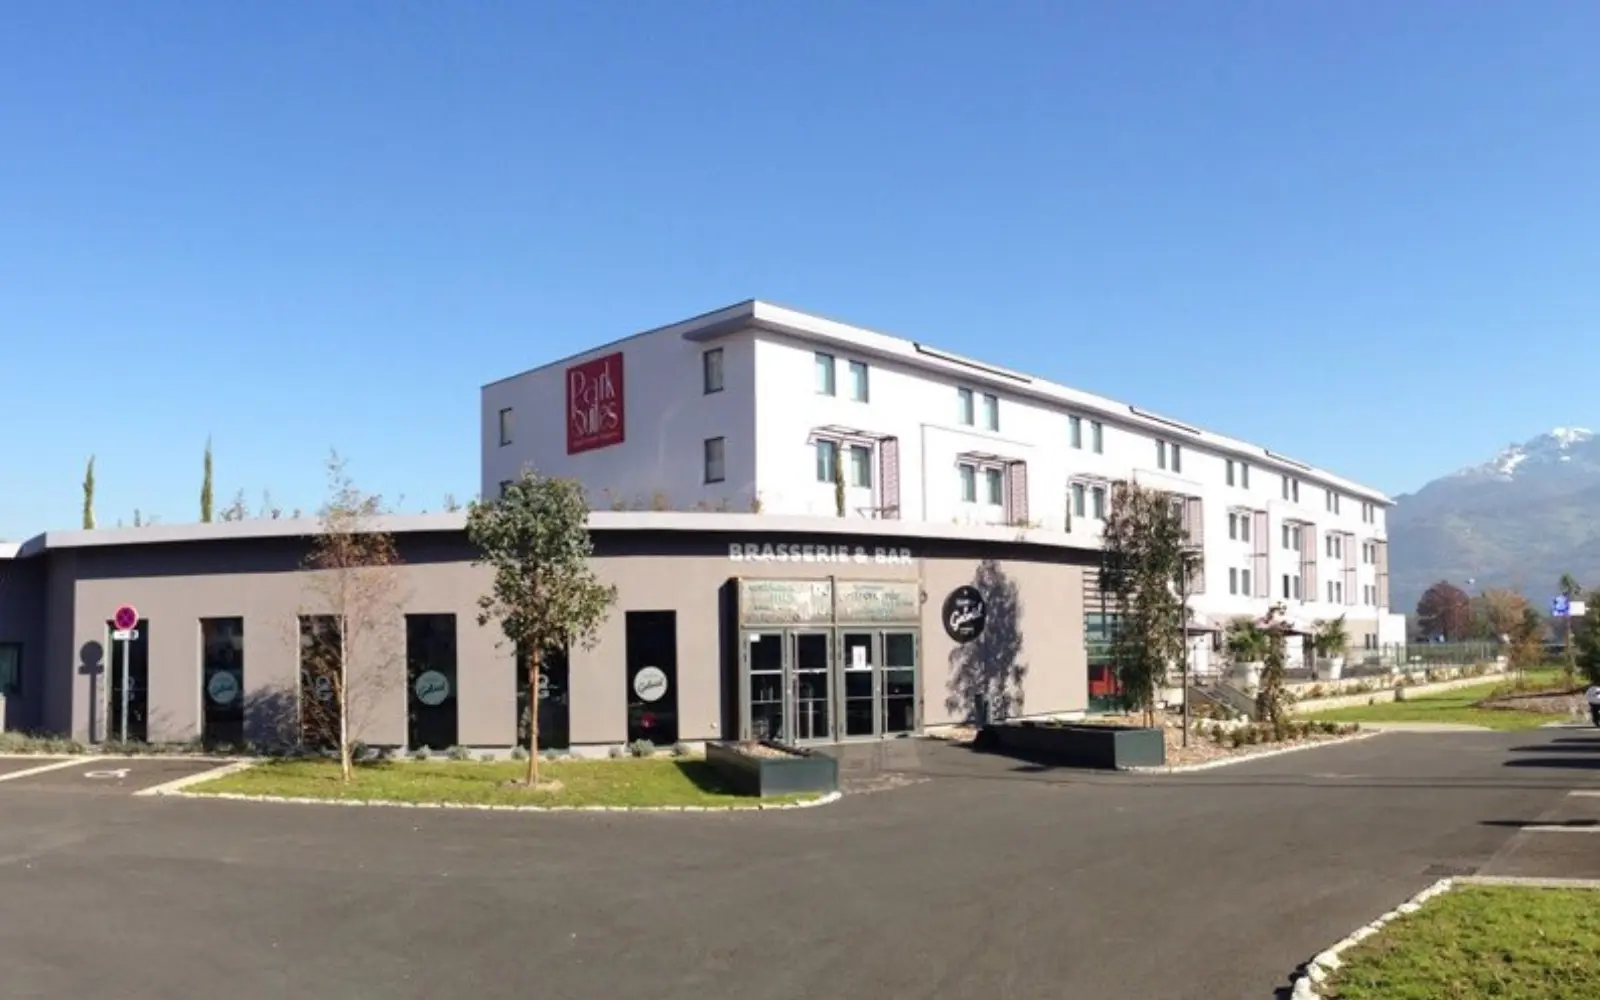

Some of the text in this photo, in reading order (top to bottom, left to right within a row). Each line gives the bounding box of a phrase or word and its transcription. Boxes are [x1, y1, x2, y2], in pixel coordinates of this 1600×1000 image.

[570, 360, 616, 420] Park
[729, 542, 912, 565] BRASSERIE & BAR
